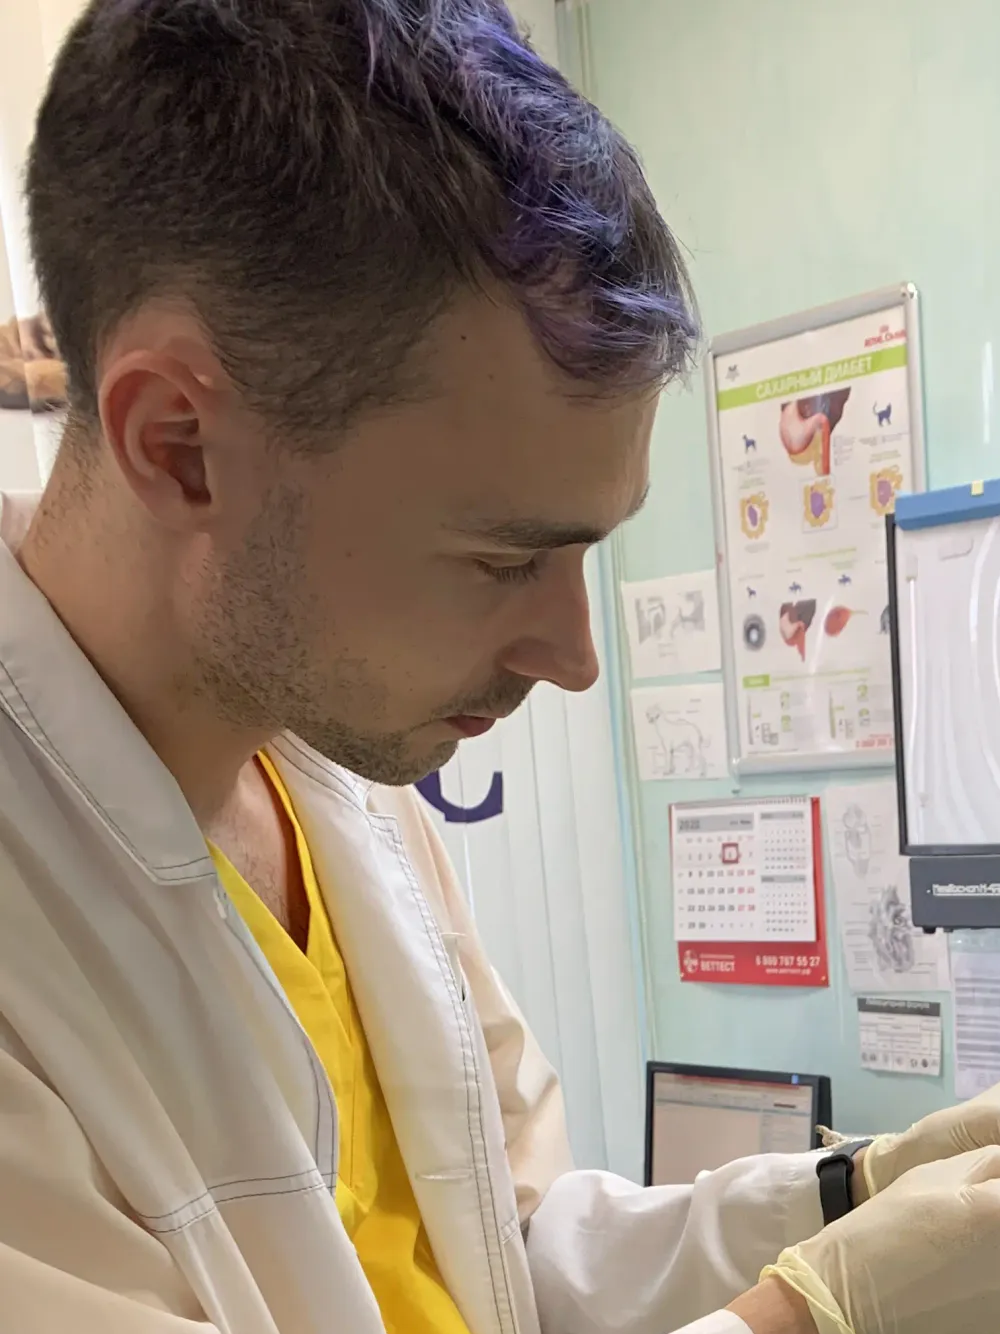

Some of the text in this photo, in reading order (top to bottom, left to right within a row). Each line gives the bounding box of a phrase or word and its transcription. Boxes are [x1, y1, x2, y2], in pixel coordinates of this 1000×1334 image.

[756, 356, 872, 399] САХАРНЫЙ ДИАБЕТ
[809, 956, 821, 967] 27
